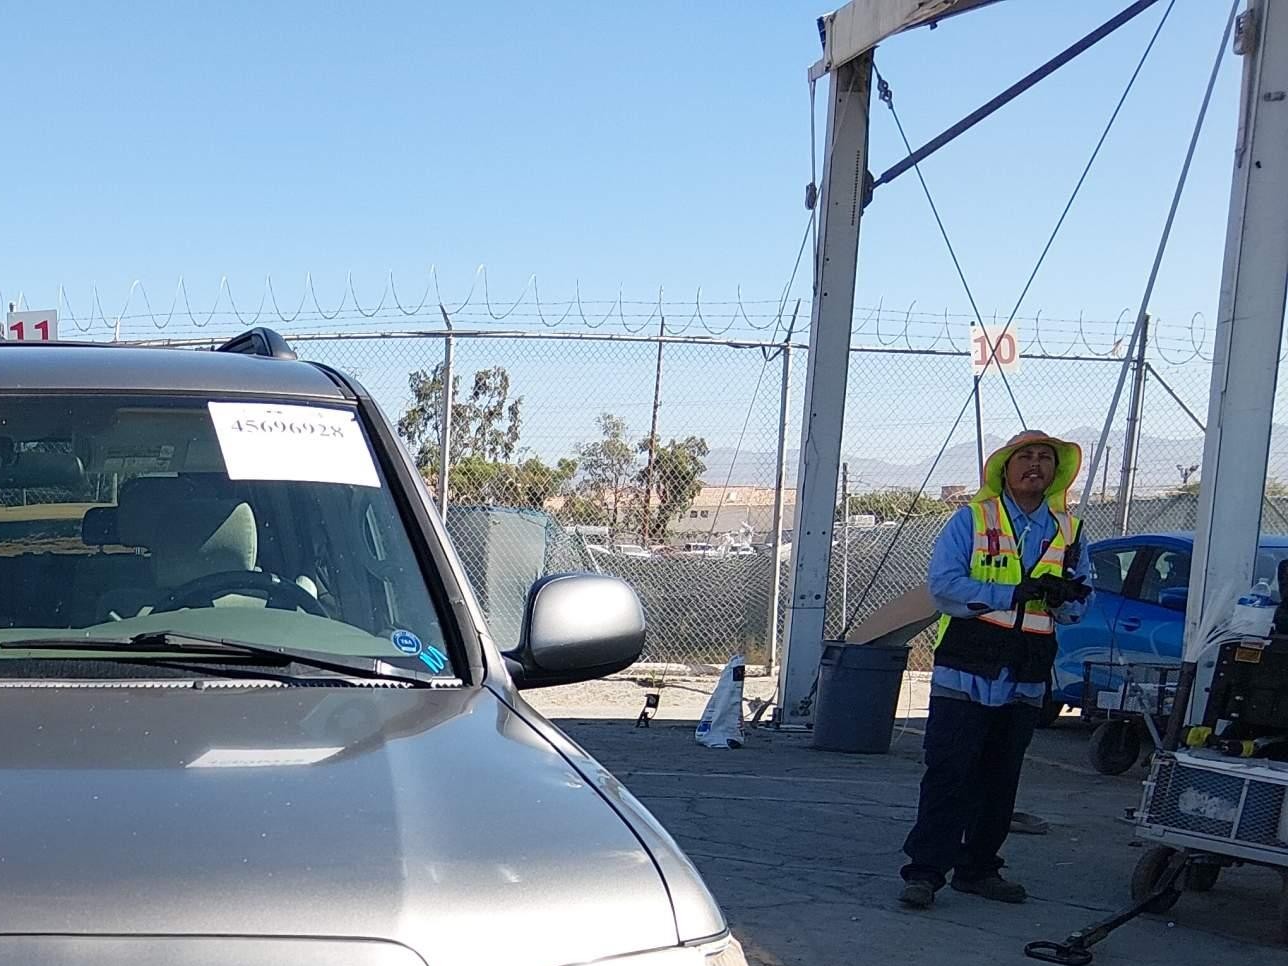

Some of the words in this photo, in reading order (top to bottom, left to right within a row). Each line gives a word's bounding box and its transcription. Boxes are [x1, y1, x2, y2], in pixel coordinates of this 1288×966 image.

[9, 319, 49, 342] 11
[973, 333, 1016, 366] 10
[231, 418, 345, 438] 45696928
